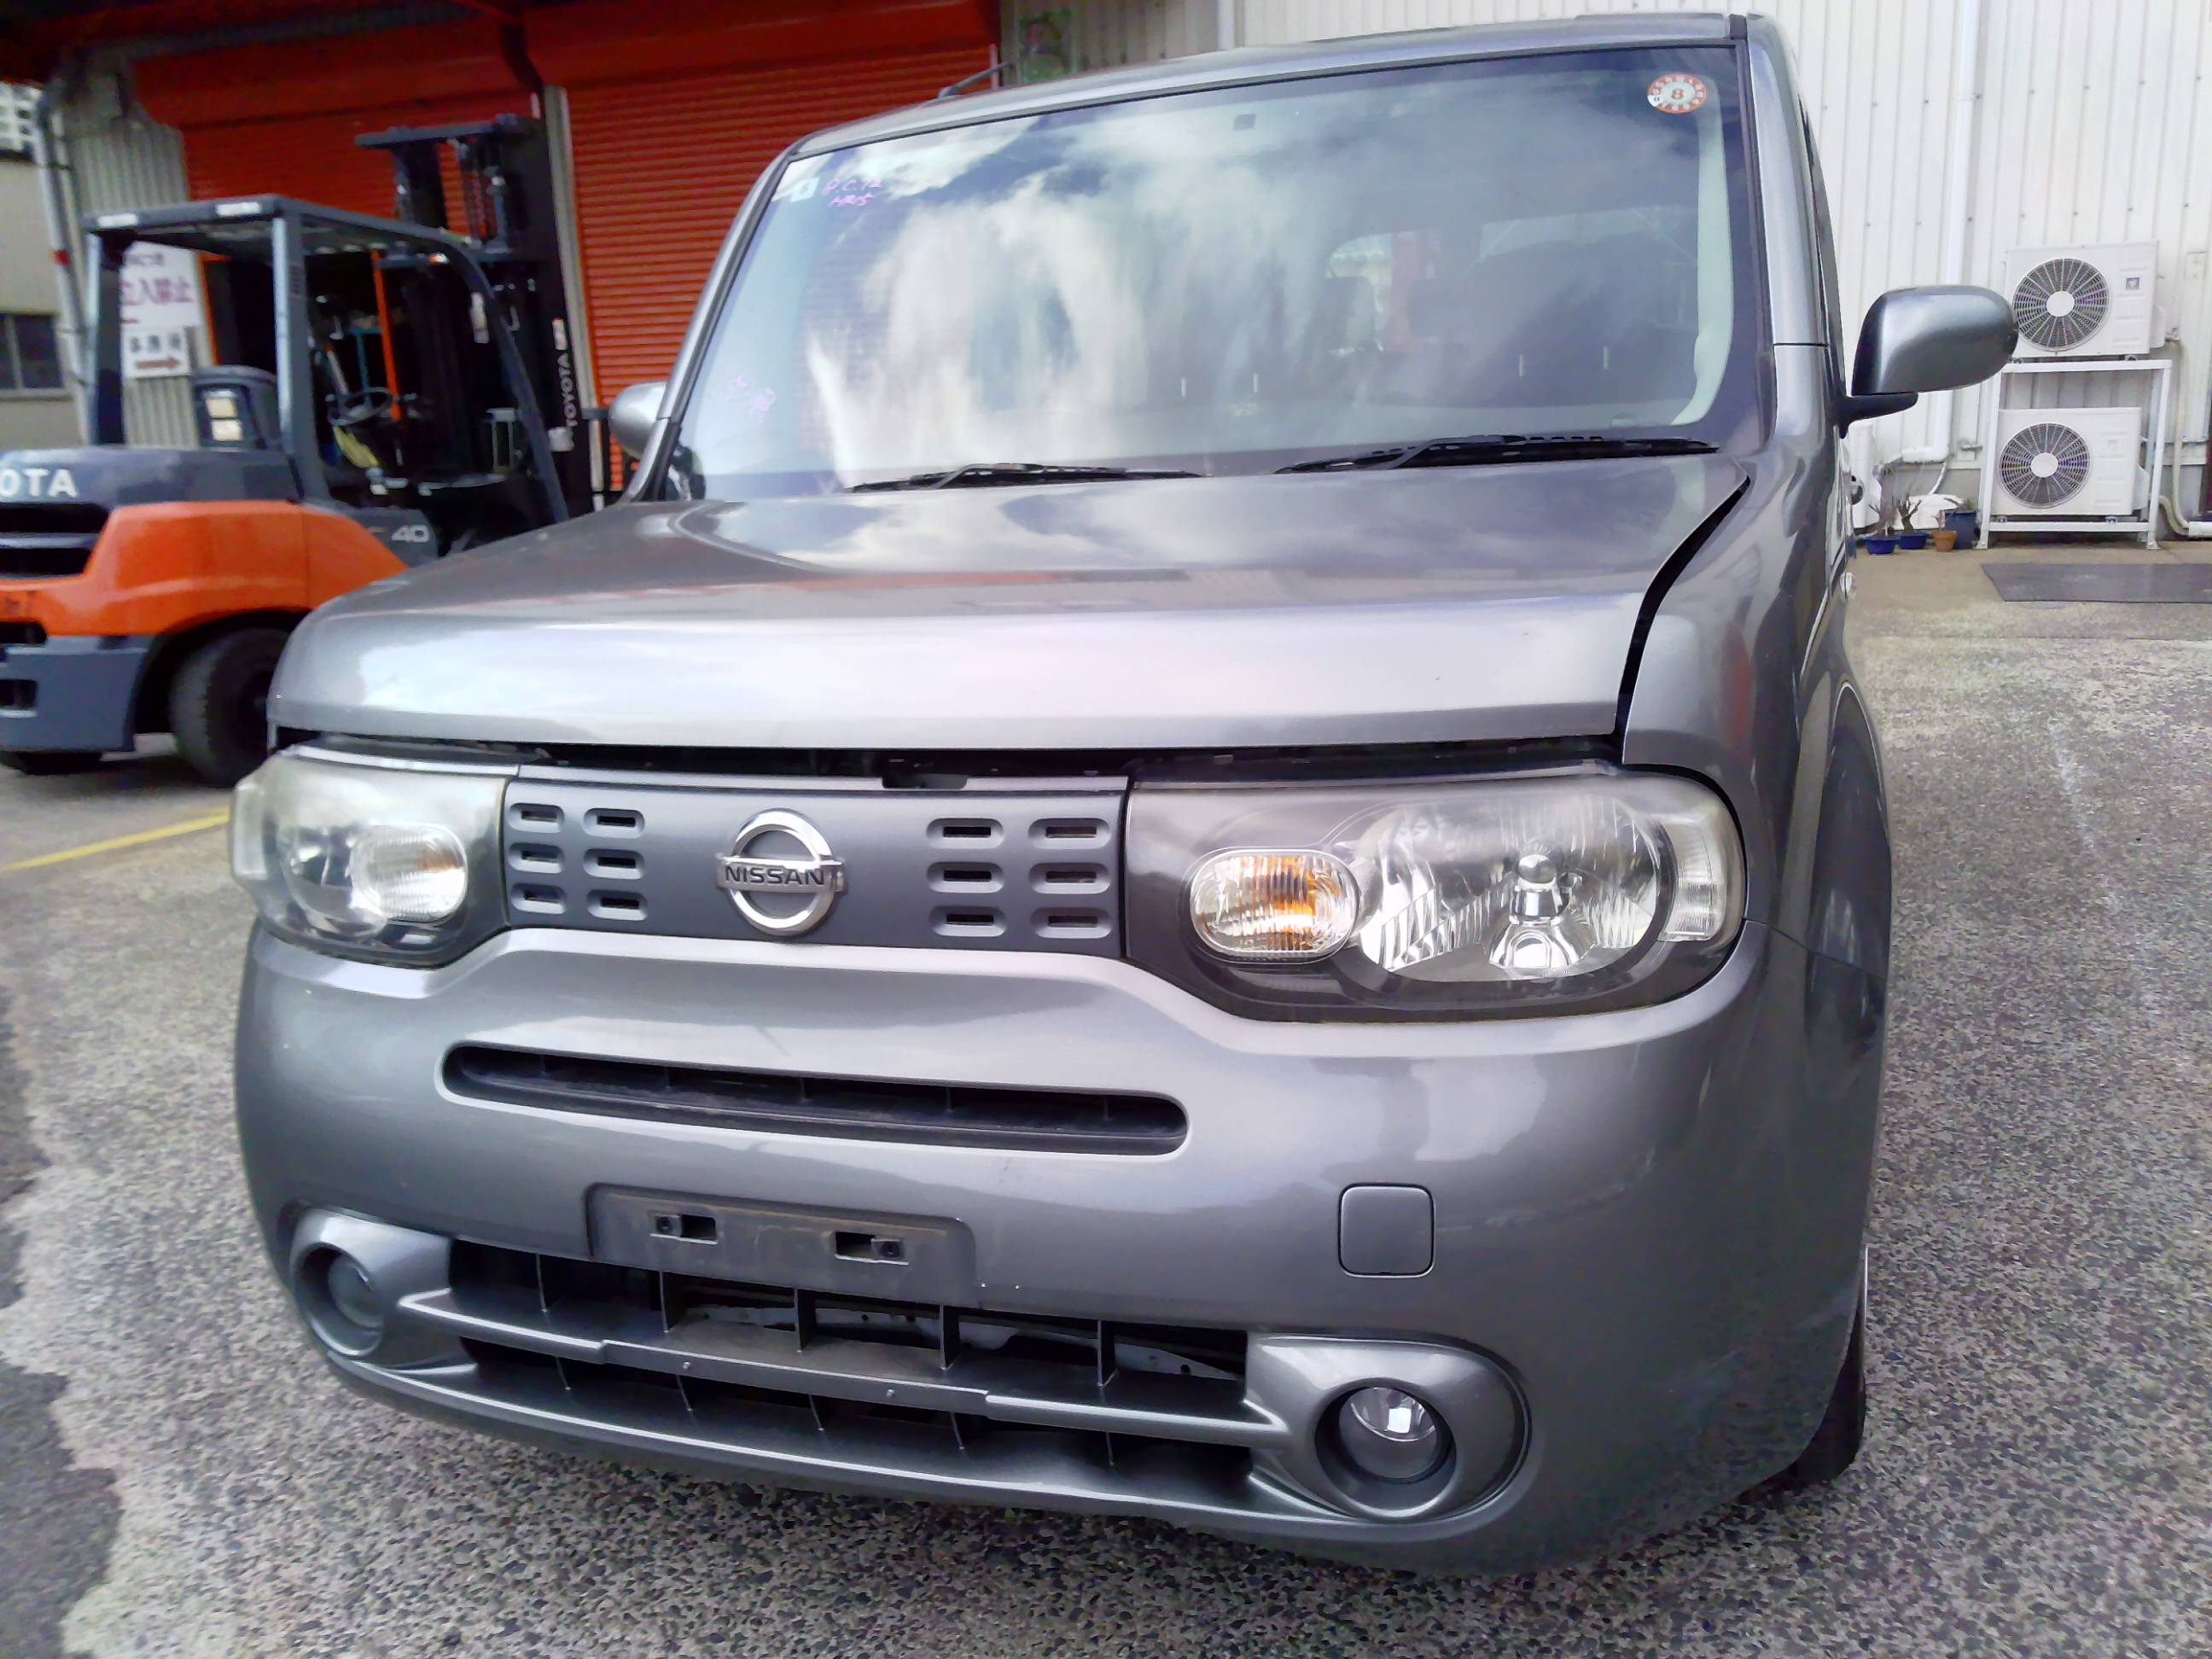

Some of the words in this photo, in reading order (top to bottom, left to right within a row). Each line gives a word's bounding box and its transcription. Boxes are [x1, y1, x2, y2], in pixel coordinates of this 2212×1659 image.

[556, 352, 578, 427] TOYOTA
[391, 524, 430, 543] 40
[725, 864, 825, 886] NISSAN
